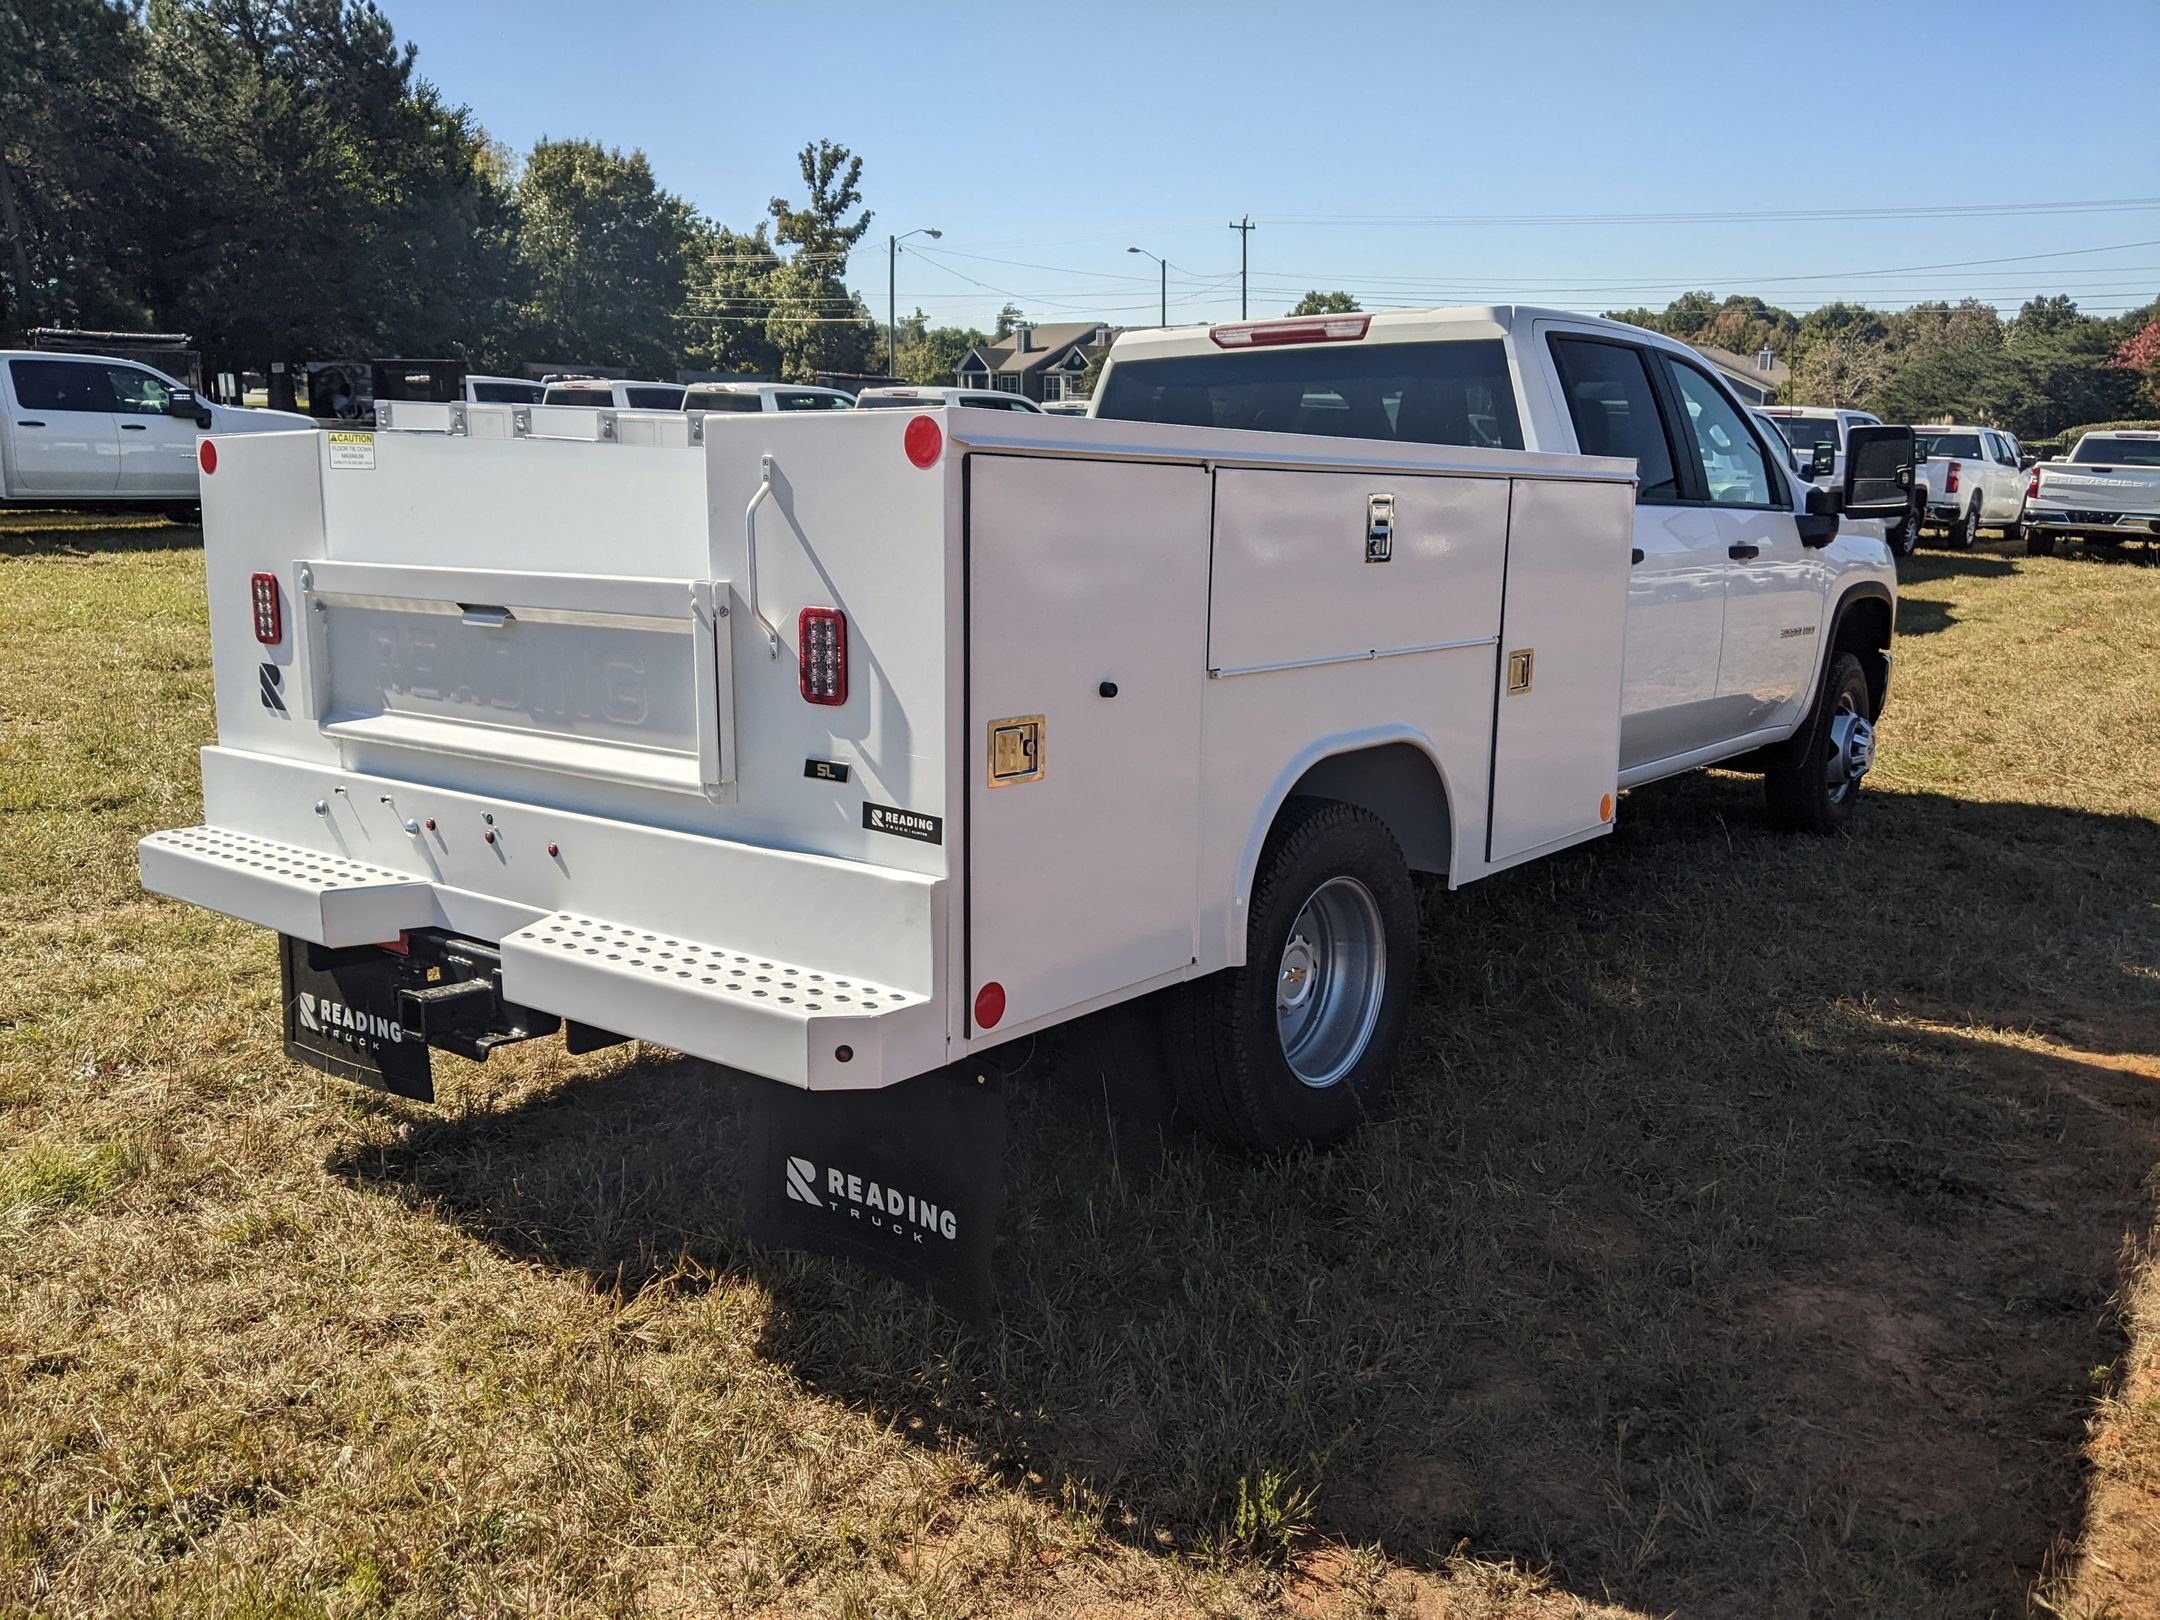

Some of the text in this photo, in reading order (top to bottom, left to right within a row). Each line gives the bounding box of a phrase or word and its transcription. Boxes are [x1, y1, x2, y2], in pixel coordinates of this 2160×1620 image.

[337, 434, 372, 443] CAUTION
[816, 763, 836, 779] SL
[885, 811, 934, 831] READING
[886, 824, 909, 833] TRUCK
[320, 999, 402, 1043] READING
[321, 1025, 380, 1050] TRUCK
[827, 1167, 957, 1240] READING
[829, 1201, 923, 1244] TRUCK
